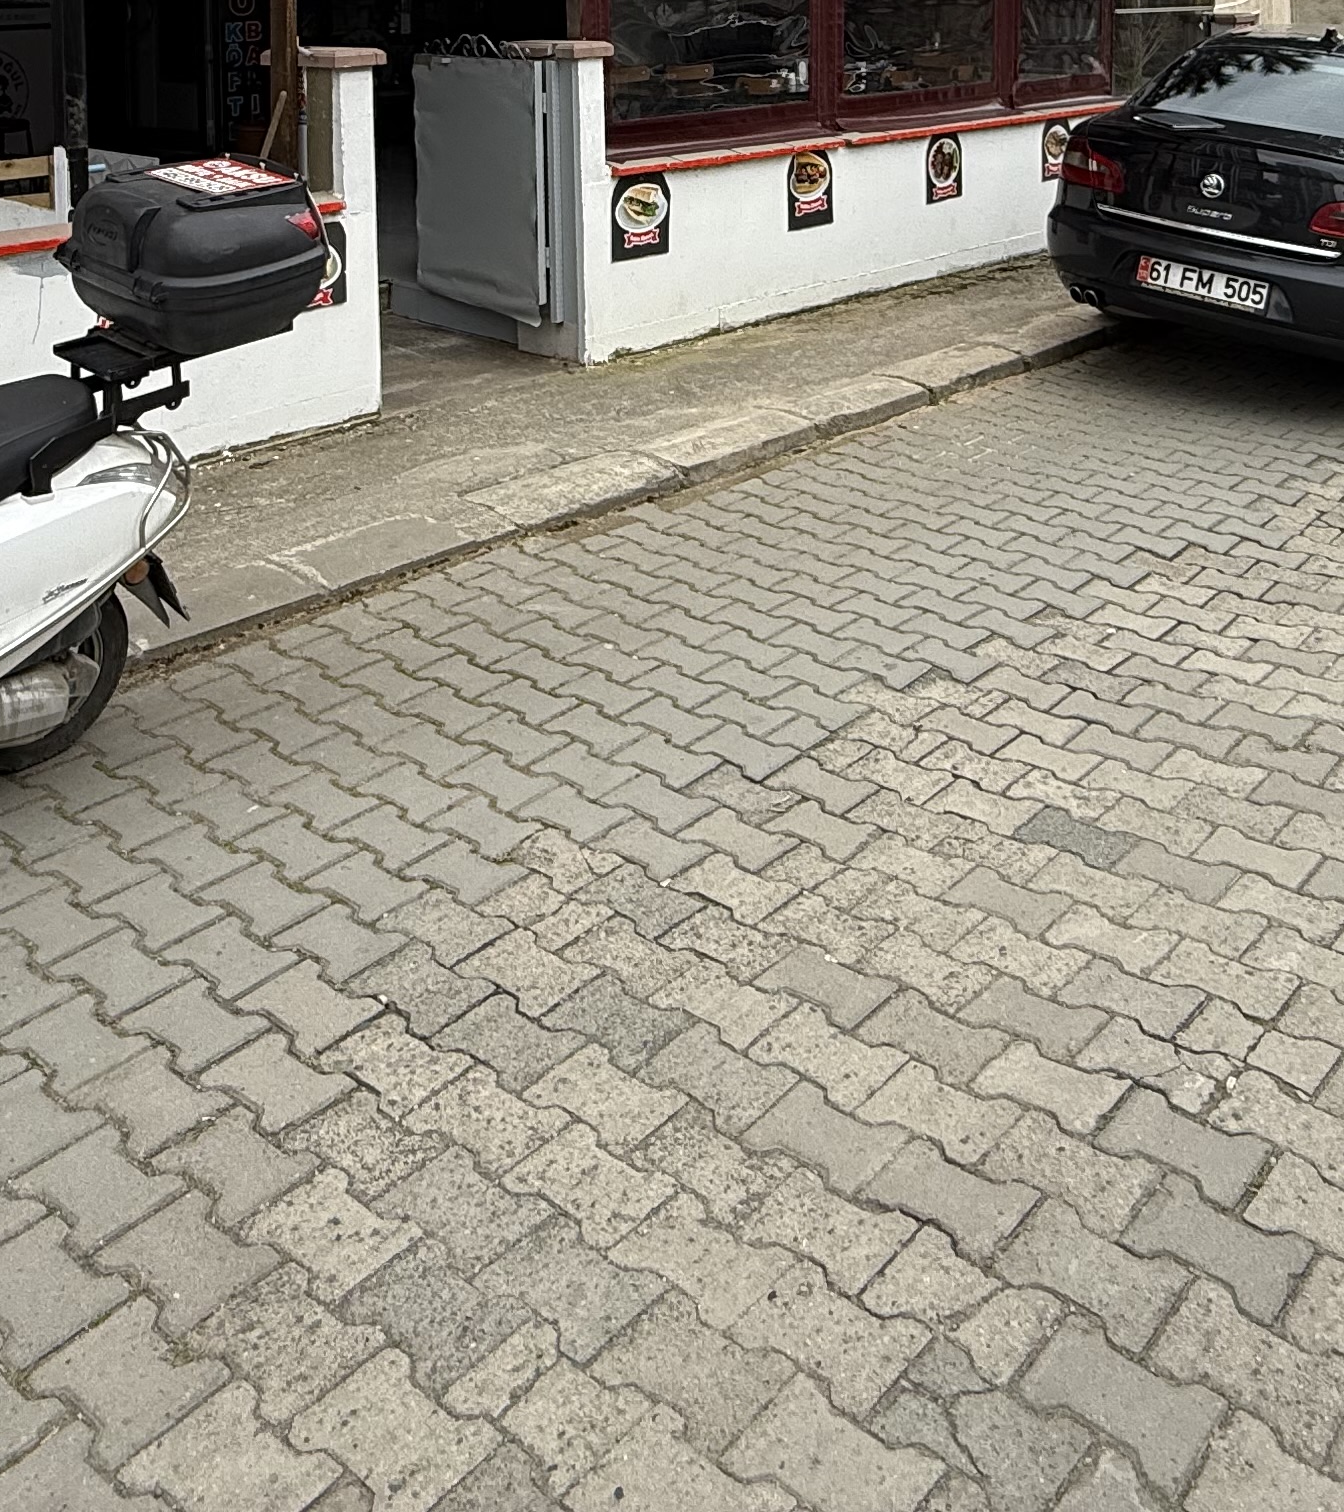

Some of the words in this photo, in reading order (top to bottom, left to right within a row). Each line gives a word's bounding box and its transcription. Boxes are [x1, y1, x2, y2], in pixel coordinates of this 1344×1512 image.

[1149, 260, 1172, 285] 61
[1179, 267, 1216, 295] FM
[1223, 276, 1267, 306] 505
